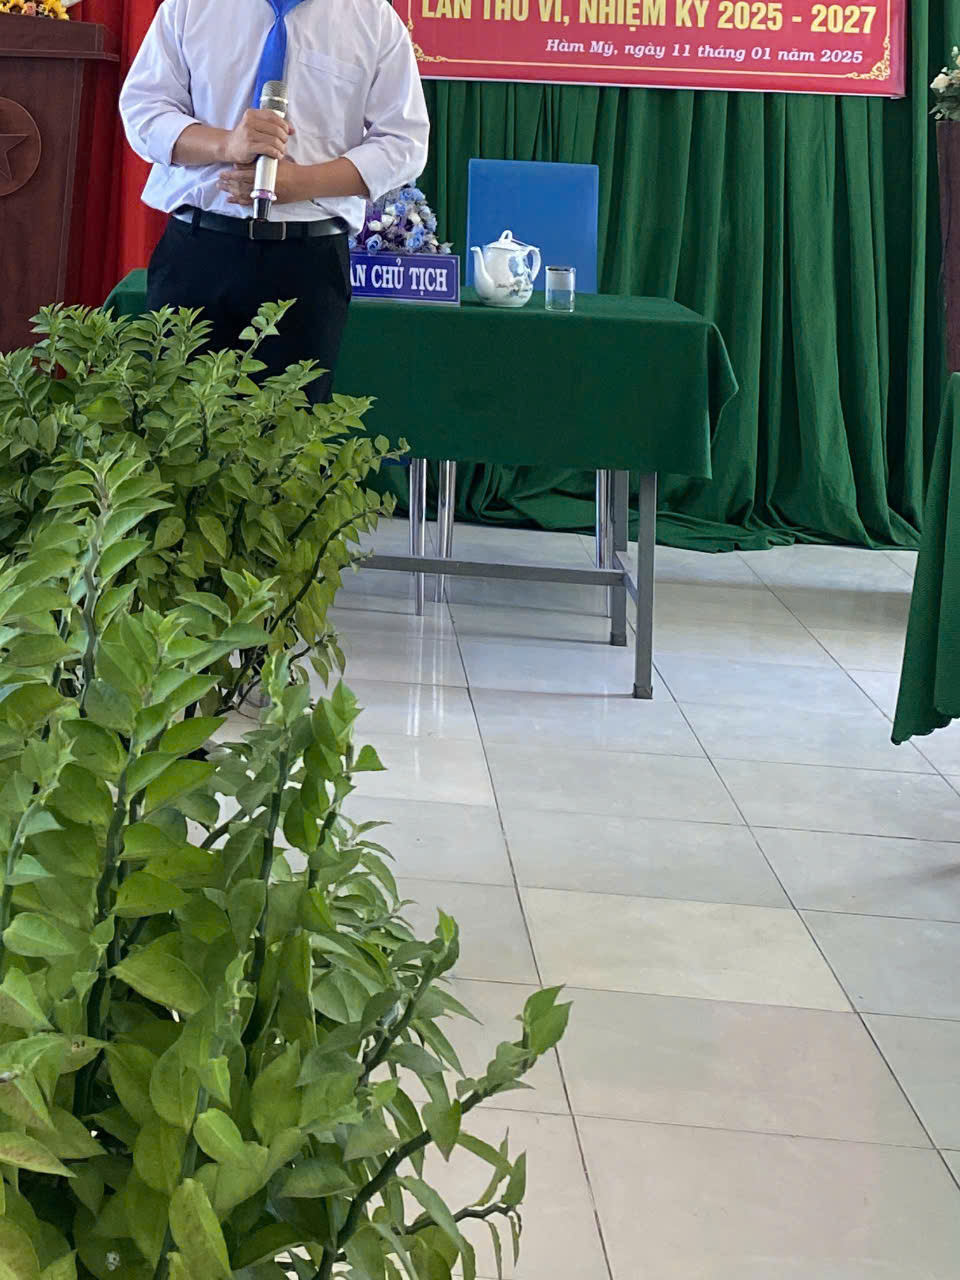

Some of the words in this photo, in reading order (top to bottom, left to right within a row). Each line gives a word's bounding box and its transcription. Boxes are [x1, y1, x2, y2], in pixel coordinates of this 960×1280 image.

[719, 1, 783, 32] 2025
[811, 5, 877, 35] 2027
[546, 39, 585, 54] Hàm
[590, 39, 619, 58] Mỹ,
[624, 42, 665, 59] ngày
[672, 43, 691, 57] 11
[697, 43, 746, 63] tháng
[752, 46, 771, 61] 01
[777, 47, 816, 63] năm
[820, 49, 863, 64] 2025
[371, 258, 404, 289] CHỦ
[409, 267, 448, 296] TỊCH
